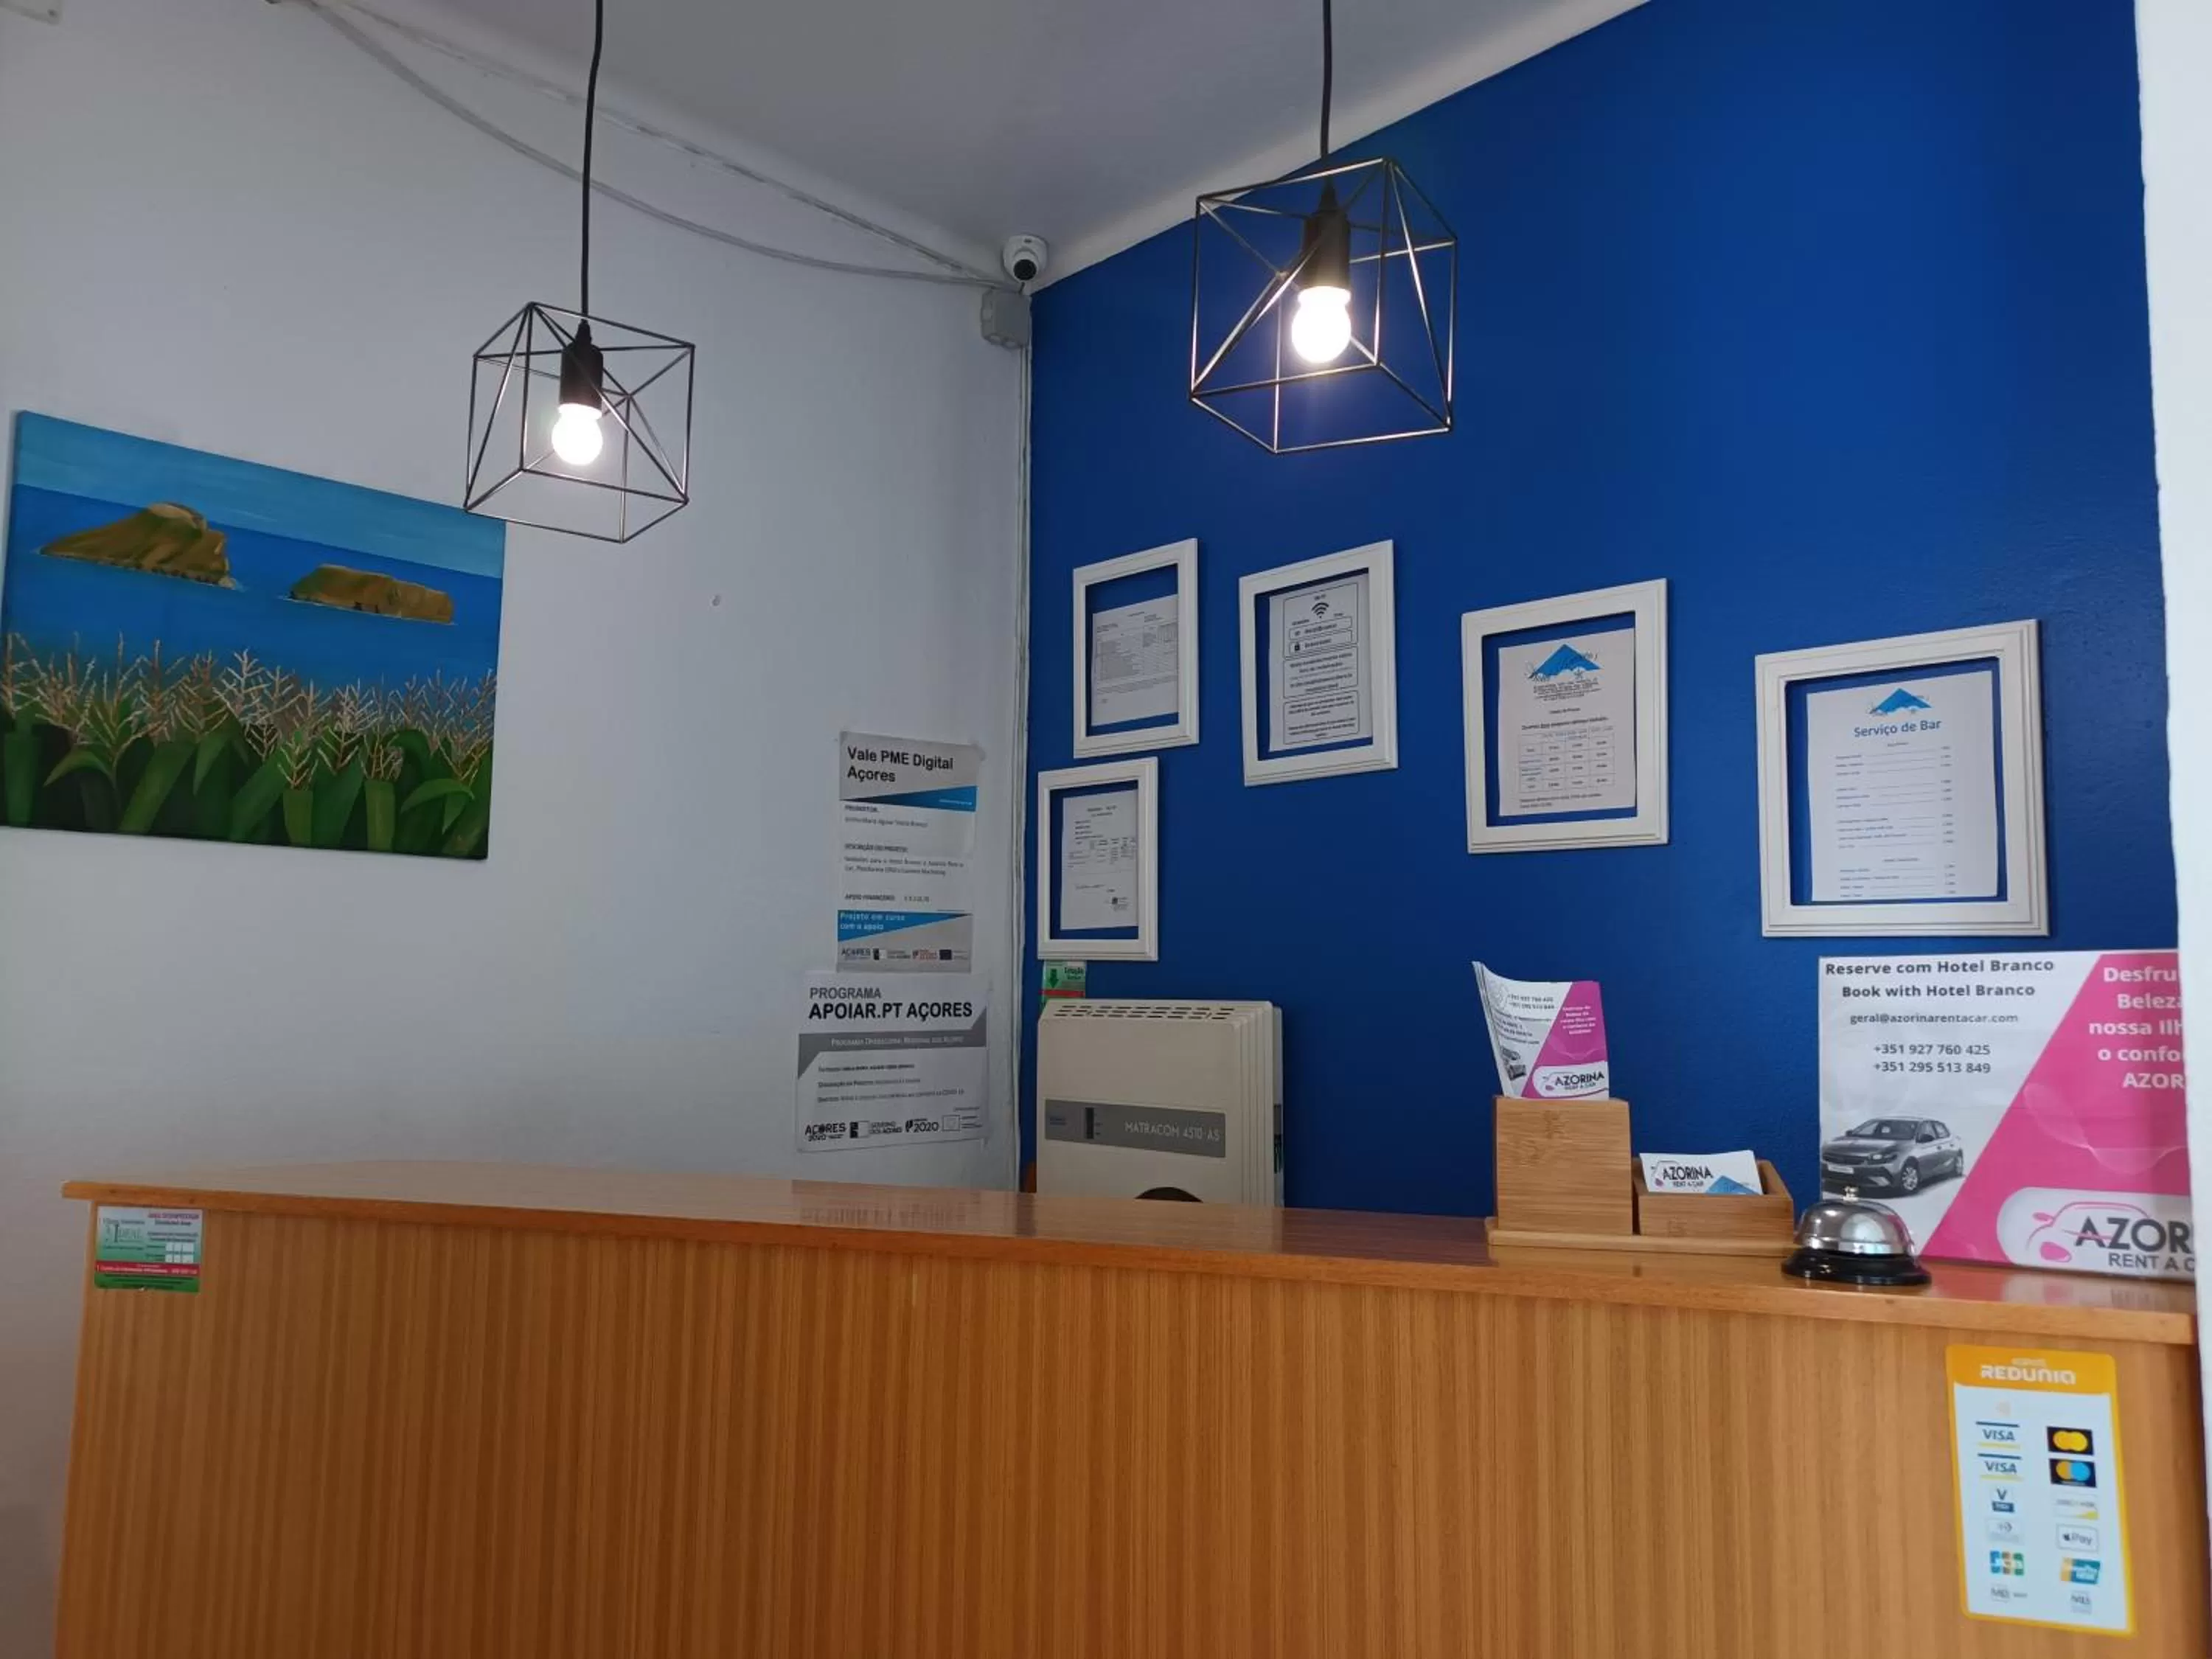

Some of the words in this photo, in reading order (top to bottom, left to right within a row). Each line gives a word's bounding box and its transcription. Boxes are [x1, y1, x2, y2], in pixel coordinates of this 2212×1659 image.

[1854, 724, 1897, 737] Serviço
[1901, 723, 1916, 732] de
[1920, 720, 1942, 731] Bar
[847, 745, 877, 762] Vale
[880, 750, 909, 765] PME
[913, 754, 953, 771] Digital
[847, 765, 896, 782] Açores
[1826, 961, 1891, 975] Reserve
[1896, 962, 1931, 974] com
[1937, 960, 1985, 974] Hotel
[1990, 959, 2054, 973] Branco
[810, 987, 881, 999] PROGRAMA
[1842, 986, 1881, 998] Book
[1885, 985, 1921, 998] with
[1926, 984, 1970, 997] Hotel
[1975, 984, 2036, 997] Branco
[809, 1002, 903, 1020] APOIAR.PT
[906, 1001, 973, 1021] AÇORES
[1850, 1011, 2019, 1025] geral@azorinarentacar.com
[2089, 1022, 2153, 1035] nossa
[1874, 1043, 1905, 1056] +351
[1908, 1043, 1934, 1056] 927
[1938, 1043, 1962, 1056] 760
[1966, 1043, 1991, 1056] 425
[2098, 1048, 2112, 1060] o
[1874, 1061, 1905, 1074] +351
[1908, 1061, 1934, 1074] 295
[1937, 1061, 1962, 1074] 513
[1966, 1061, 1991, 1074] 849
[1554, 1071, 1604, 1087] AZORINA
[804, 1123, 846, 1136] AÇORES
[914, 1121, 939, 1133] 2020
[1663, 1164, 1714, 1180] AZORINA
[2108, 1252, 2160, 1269] RENT
[2164, 1256, 2179, 1270] A
[1983, 1429, 2015, 1441] VISA
[1984, 1461, 2017, 1473] VISA
